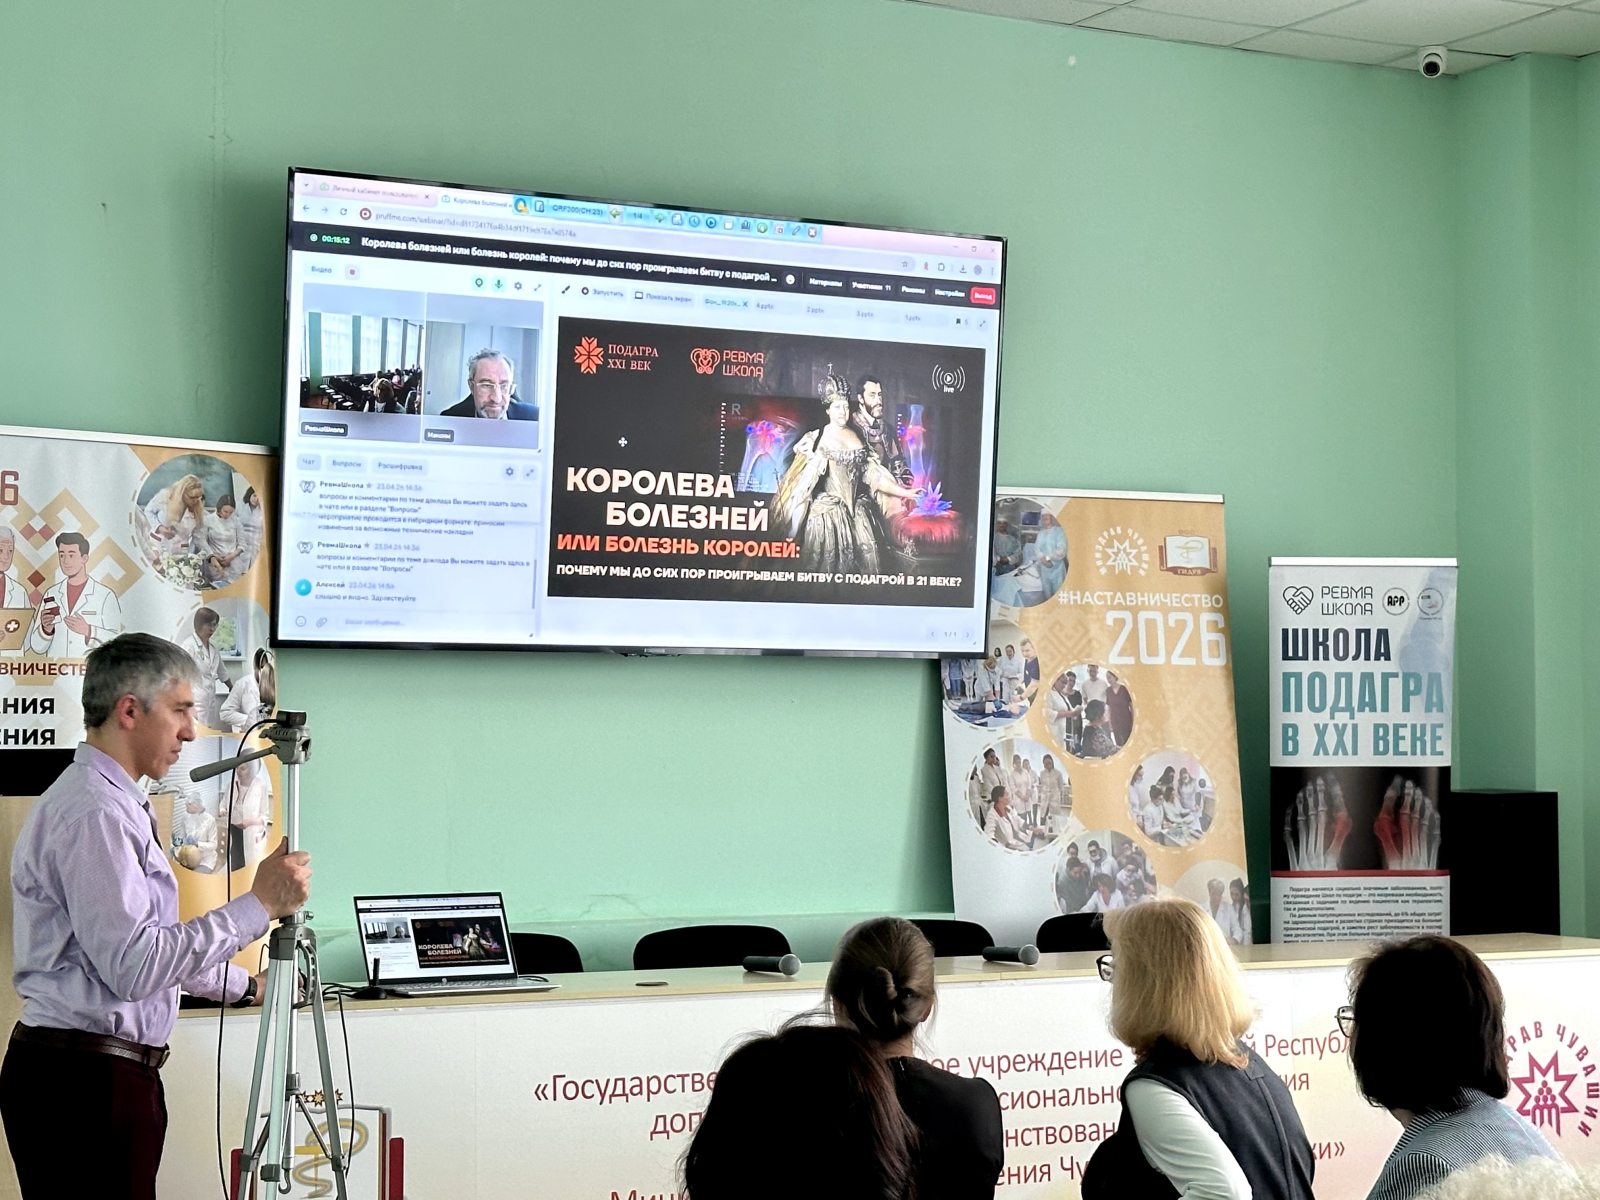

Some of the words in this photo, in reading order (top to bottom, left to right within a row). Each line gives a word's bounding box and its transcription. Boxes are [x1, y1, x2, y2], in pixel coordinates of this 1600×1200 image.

[361, 237, 407, 250] Королева
[408, 241, 451, 253] болезней
[453, 246, 470, 256] или
[471, 247, 508, 259] болезнь
[509, 252, 549, 262] королей:
[549, 256, 581, 267] почему
[582, 258, 596, 267] мы
[597, 260, 608, 268] до
[609, 262, 625, 270] сих
[626, 263, 641, 272] пор
[643, 263, 699, 275] проигрываем
[700, 267, 724, 279] битву
[731, 272, 770, 282] подагрой
[608, 344, 659, 357] ПОДАГРА
[723, 350, 764, 364] РЕВМА
[607, 359, 626, 369] XXI
[630, 361, 652, 371] ВЕК
[722, 364, 764, 378] ШКОЛА
[567, 467, 736, 499] КОРОЛЕВА
[606, 501, 769, 532] БОЛЕЗНЕЙ
[557, 534, 600, 551] ИЛИ
[605, 536, 700, 555] БОЛЕЗНЬ
[704, 539, 800, 559] КОРОЛЕЙ:
[556, 565, 608, 577] ПОЧЕМУ
[609, 566, 631, 577] МЫ
[633, 567, 652, 579] ДО
[653, 568, 679, 579] СИХ
[681, 569, 706, 580] ПОР
[708, 569, 795, 582] ПРОИГРЫВАЕМ
[797, 572, 833, 583] БИТВУ
[834, 574, 844, 583] С
[846, 573, 905, 586] ПОДАГРОЙ
[907, 576, 915, 585] В
[916, 576, 928, 586] 21
[930, 576, 962, 587] ВЕКЕ?
[1058, 591, 1224, 608] #НАСТАВНИЧЕСТВО
[1321, 586, 1373, 599] РЕВМА
[1321, 603, 1373, 616] ШКОЛА
[1105, 611, 1228, 667] 2026
[1281, 628, 1392, 662] ШКОЛА
[0, 698, 55, 714] НИЯ
[1282, 671, 1444, 720] ПОДАГРА
[0, 729, 55, 745] НИЯ
[1281, 723, 1299, 756] В
[1312, 723, 1359, 756] XXI
[1373, 723, 1444, 756] ВЕКЕ
[534, 1071, 718, 1105] «Государстве
[968, 1048, 1123, 1080] учреждение
[1556, 1024, 1600, 1137] ЧУВАШИИ
[998, 1085, 1122, 1111] сиональн
[1005, 1122, 1117, 1148] нствован
